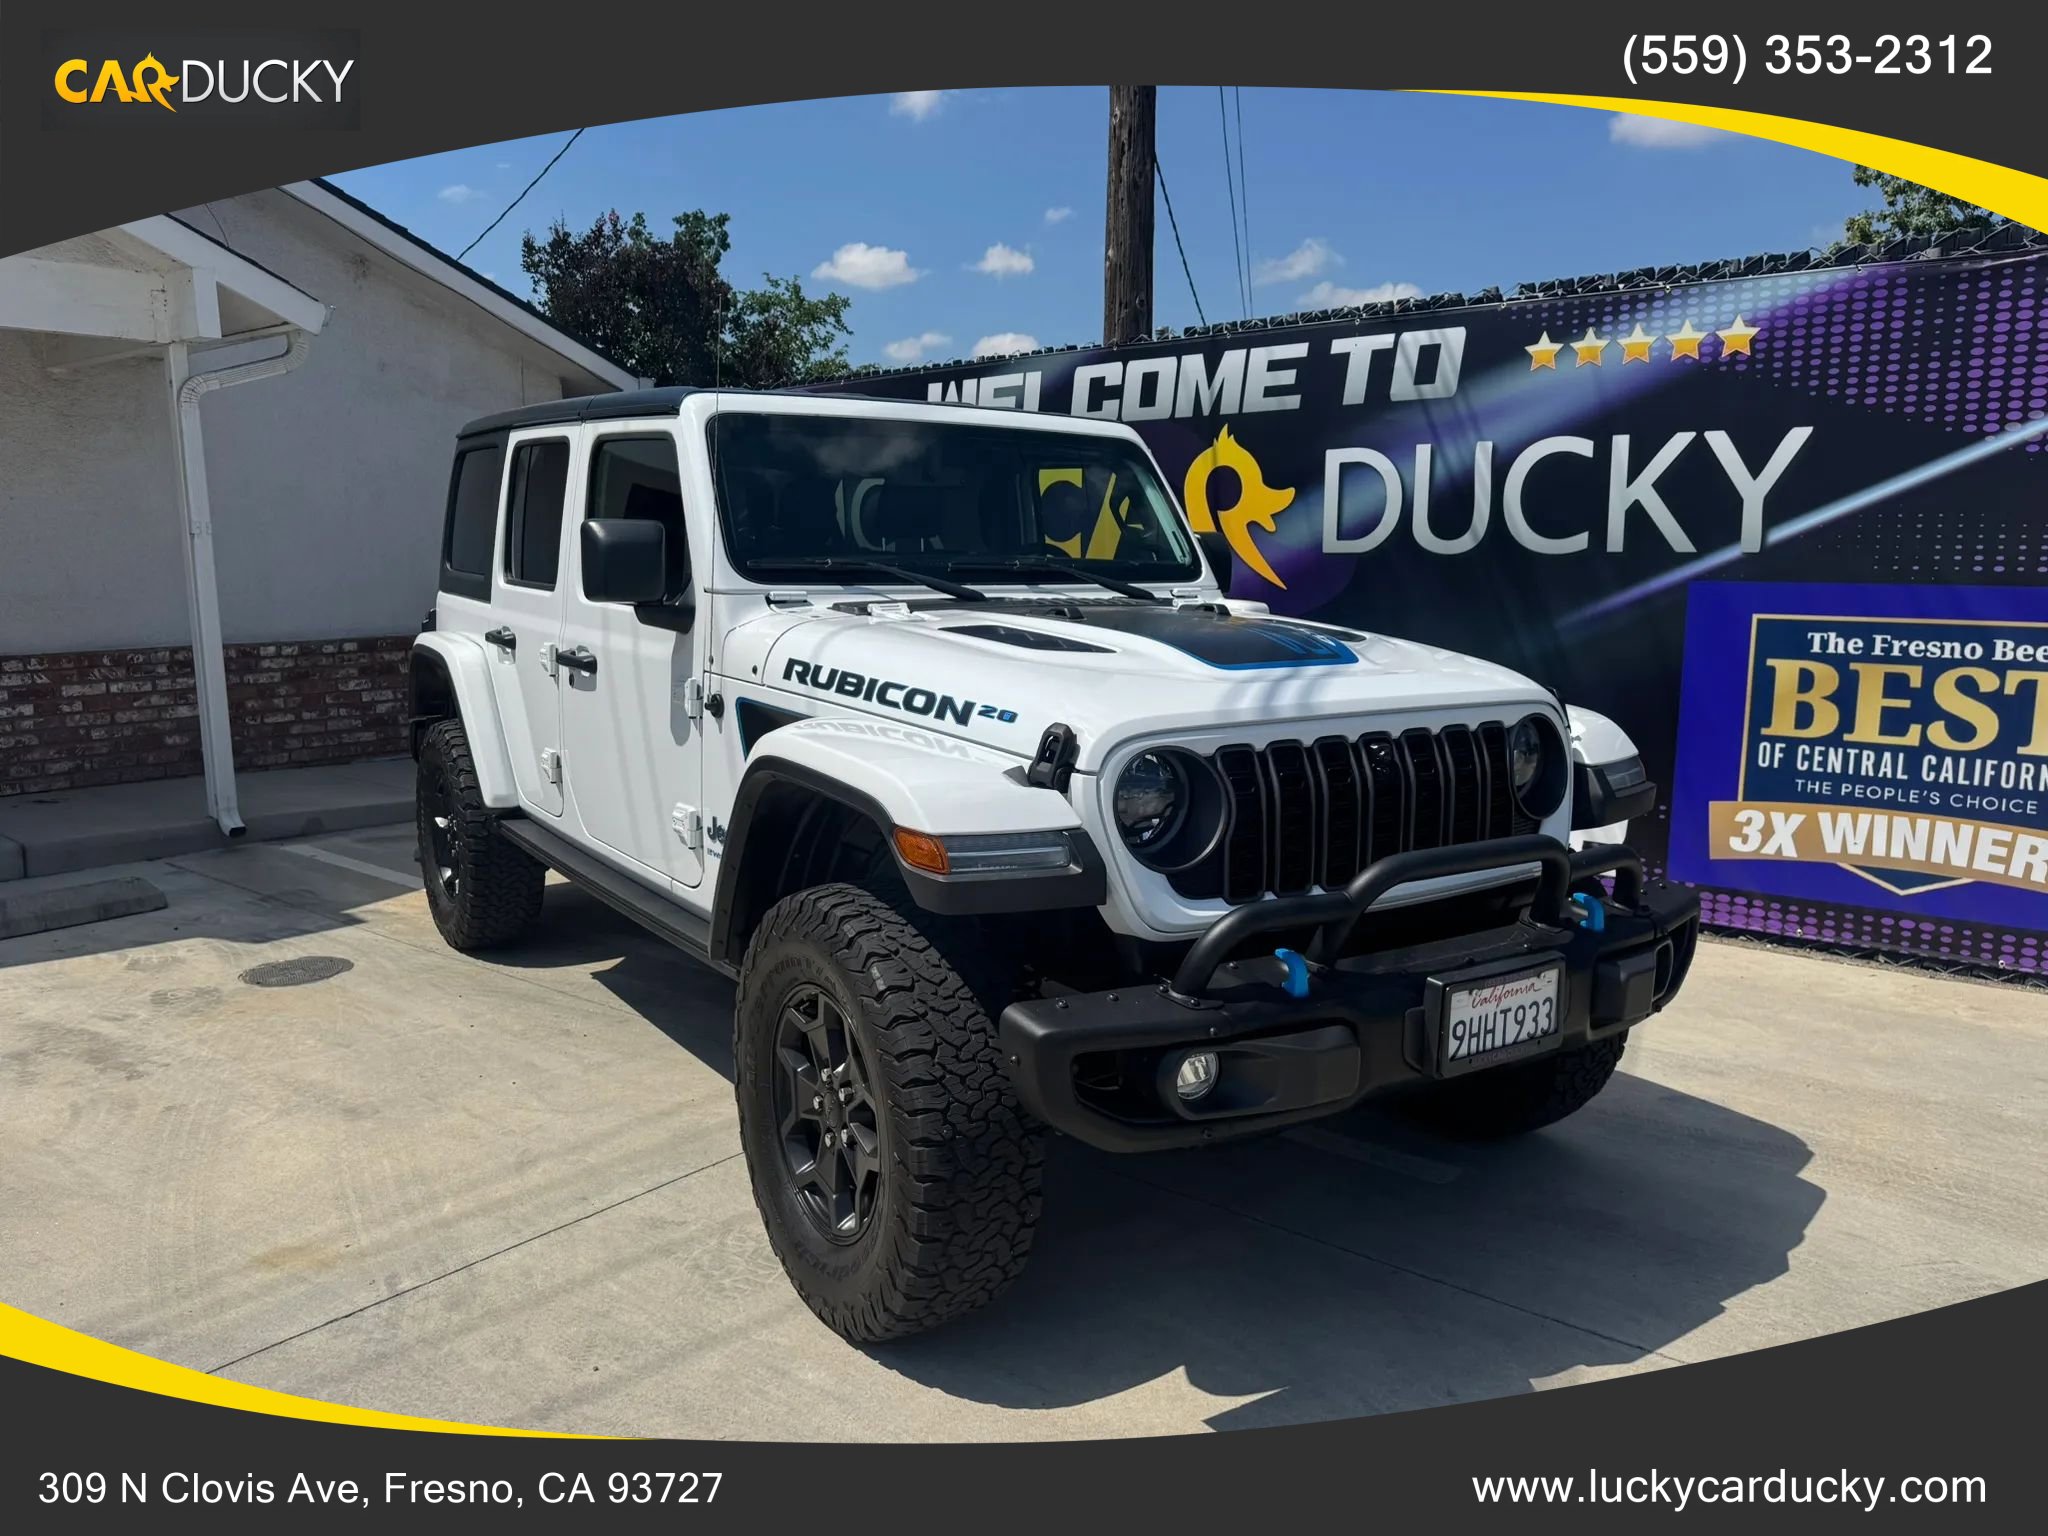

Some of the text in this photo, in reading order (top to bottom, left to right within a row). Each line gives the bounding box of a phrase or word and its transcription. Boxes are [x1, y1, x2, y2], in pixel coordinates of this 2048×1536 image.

[1330, 326, 1466, 405] TO
[1321, 426, 1814, 555] DUCKY
[1808, 631, 2048, 664] The Fresno Bee
[782, 657, 1019, 727] RUBICON 20
[1760, 658, 2048, 757] BEST
[1757, 741, 1787, 770] OF
[1796, 744, 1909, 780] CENTRAL
[1795, 778, 2039, 815] THE PEOPLE'S CHOICE
[1728, 808, 2048, 885] 3X WINNER
[1450, 996, 1554, 1062] 9HHT933
[1471, 982, 1541, 1009] California
